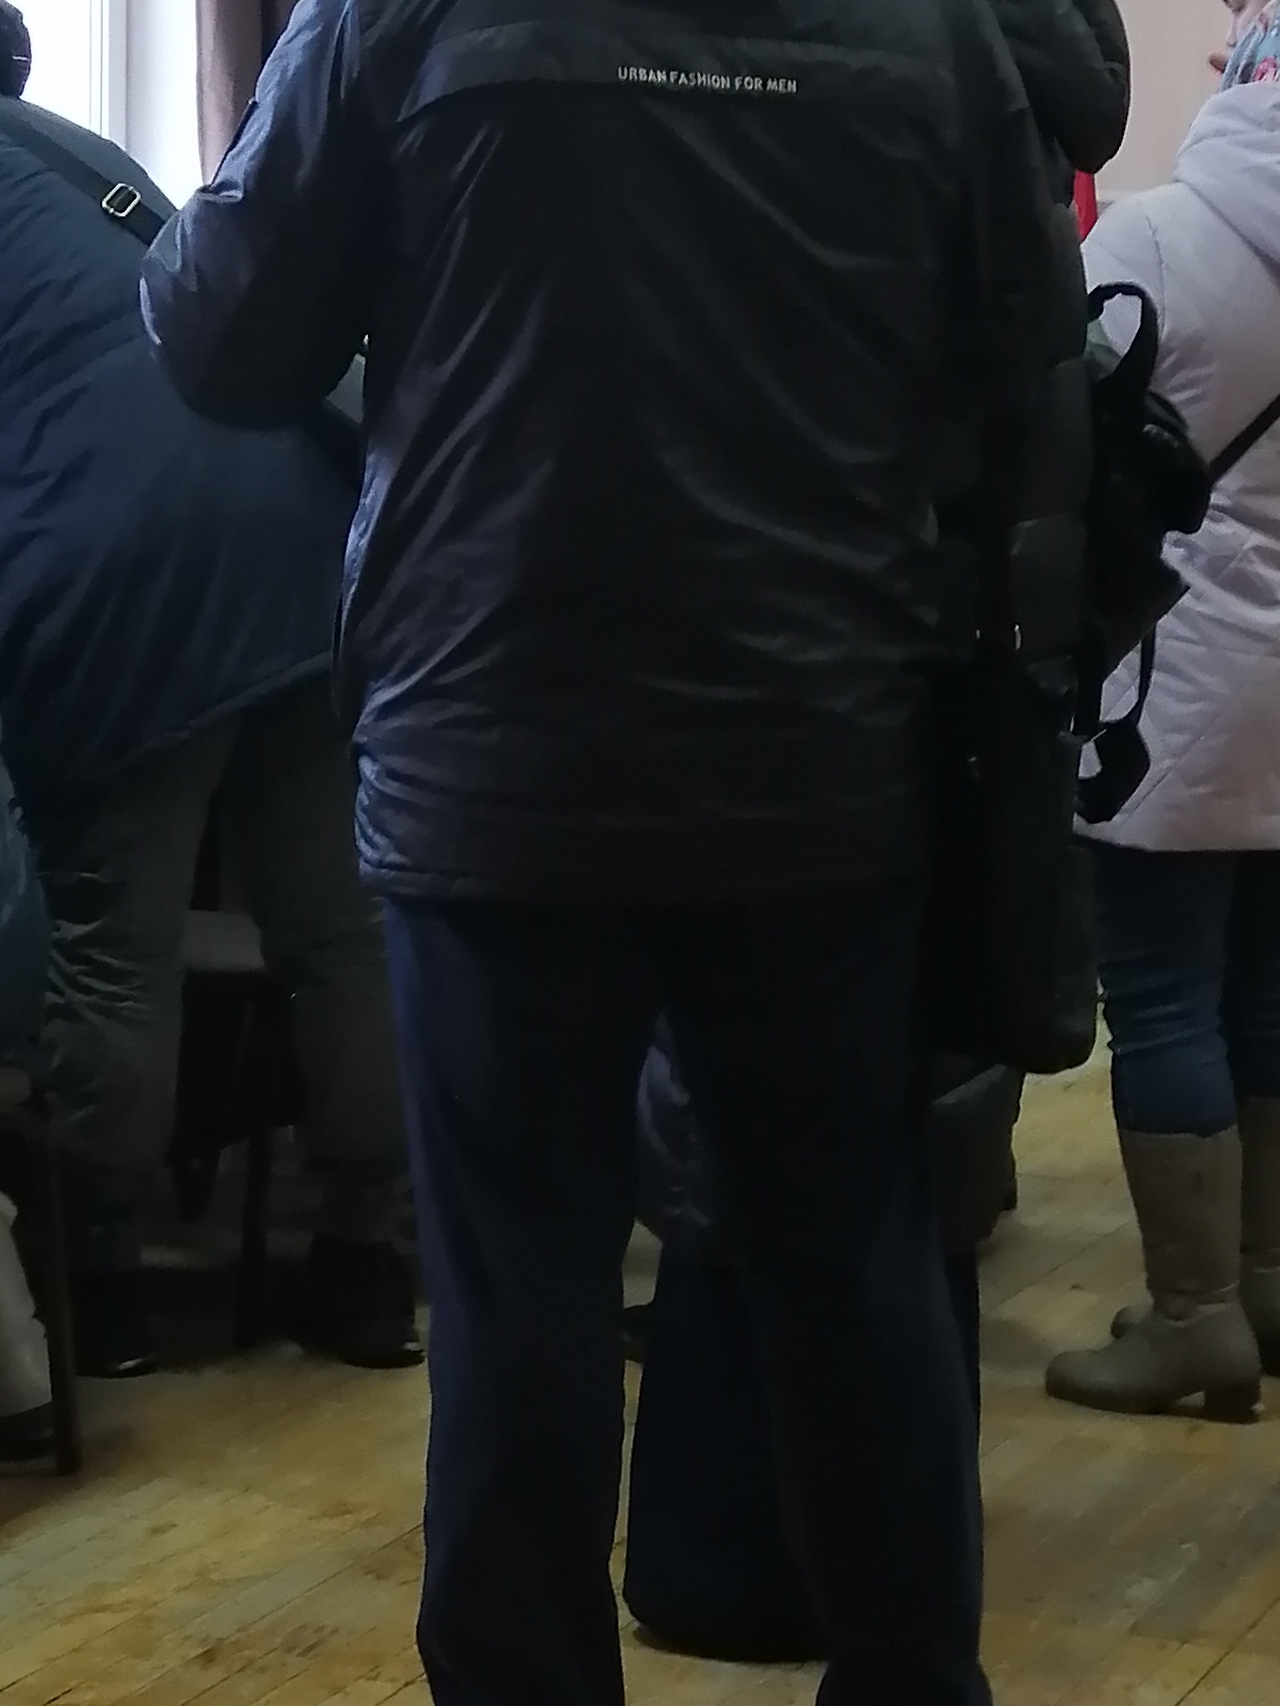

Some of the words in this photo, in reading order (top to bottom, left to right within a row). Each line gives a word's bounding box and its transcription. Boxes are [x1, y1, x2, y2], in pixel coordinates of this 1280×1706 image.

[618, 66, 666, 83] URBAN
[670, 70, 730, 89] FASHION
[734, 76, 763, 91] FOR
[766, 78, 797, 93] MEN
